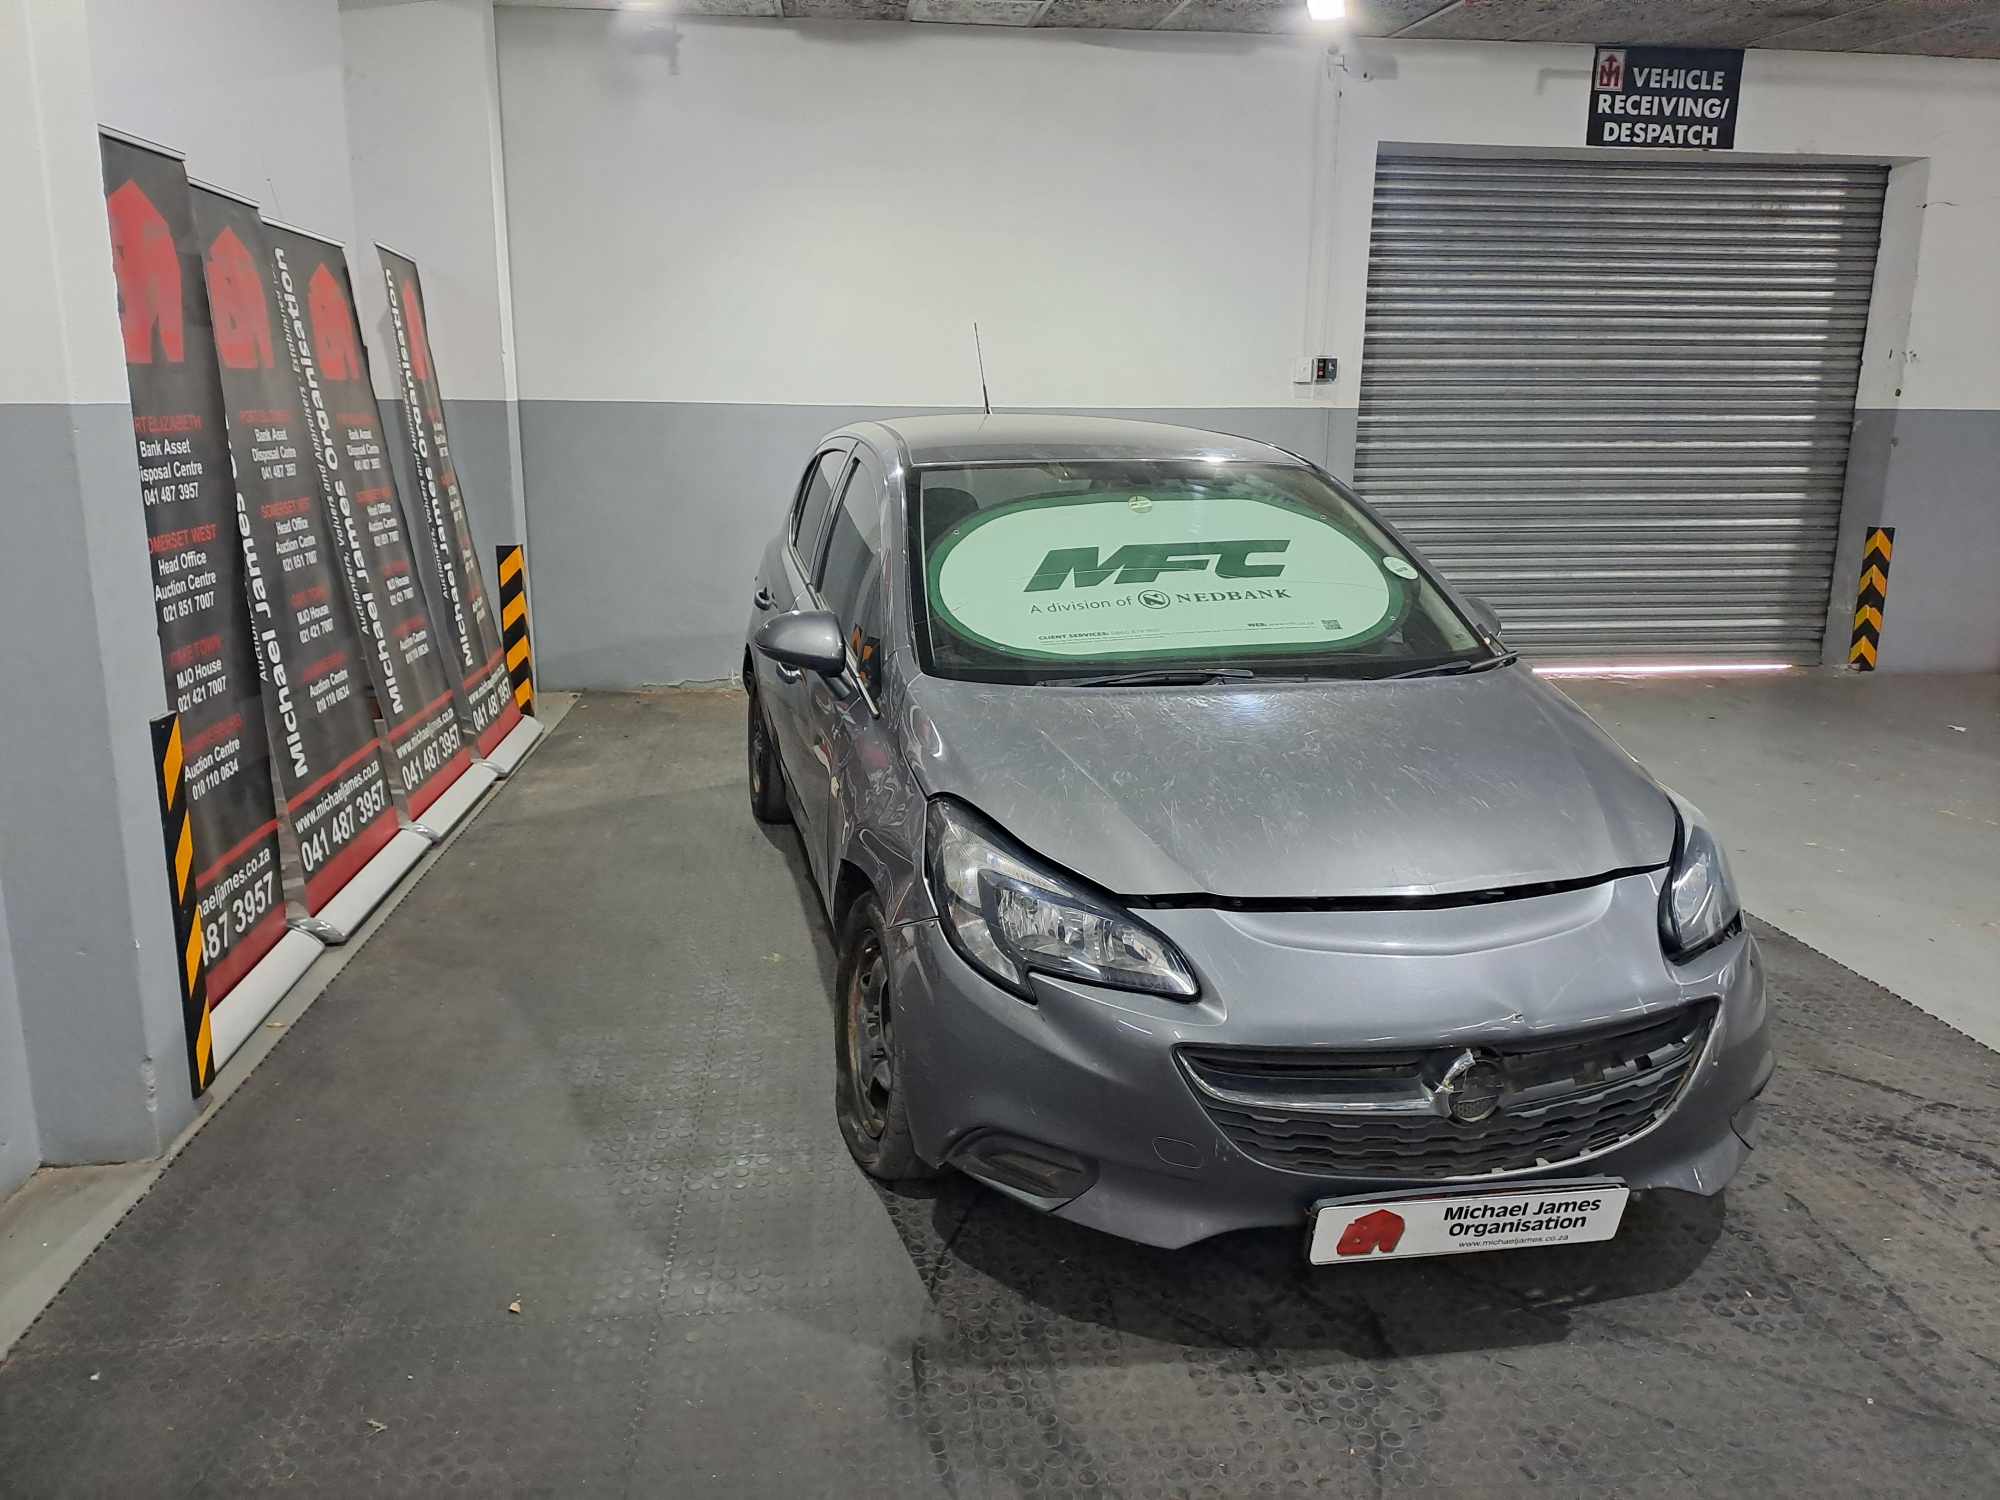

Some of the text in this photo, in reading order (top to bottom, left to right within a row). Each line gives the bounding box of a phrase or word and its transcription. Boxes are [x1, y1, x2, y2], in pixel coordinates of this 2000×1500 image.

[1633, 67, 1725, 91] VEHICLE
[1598, 93, 1730, 119] RECEIVING/
[1603, 122, 1718, 146] DESPATCH
[275, 248, 338, 470] Organisation
[385, 268, 428, 459] Organisation
[140, 438, 191, 458] Bank Asset
[140, 461, 203, 485] isposal Centre
[317, 463, 331, 491] and
[144, 482, 199, 506] 041 487 3957
[425, 467, 449, 555] James
[335, 480, 370, 583] James
[158, 551, 207, 576] Head Office
[1023, 540, 1291, 592] MFC
[155, 571, 217, 602] Auction Centre
[1030, 589, 1291, 614] A division of NEDBANK
[163, 591, 215, 623] 021 851 7007
[444, 563, 473, 667] Michael
[362, 593, 403, 714] Michael
[176, 658, 222, 689] MJO House
[177, 675, 227, 713] 021 421 7007
[261, 629, 309, 778] Michael
[184, 737, 240, 782] Auction Centre
[402, 723, 461, 790] 041 487 3957
[192, 758, 239, 801] 010 110 0634
[295, 760, 380, 834] www.michaeljames.co.za
[301, 779, 385, 872] 041 487 3957
[198, 847, 271, 918] aeljames.co.za
[232, 870, 273, 933] 3957
[1443, 1199, 1602, 1221] Michael James
[1449, 1215, 1588, 1238] Organisation
[1459, 1234, 1569, 1248] www.michaeljames.co.za
